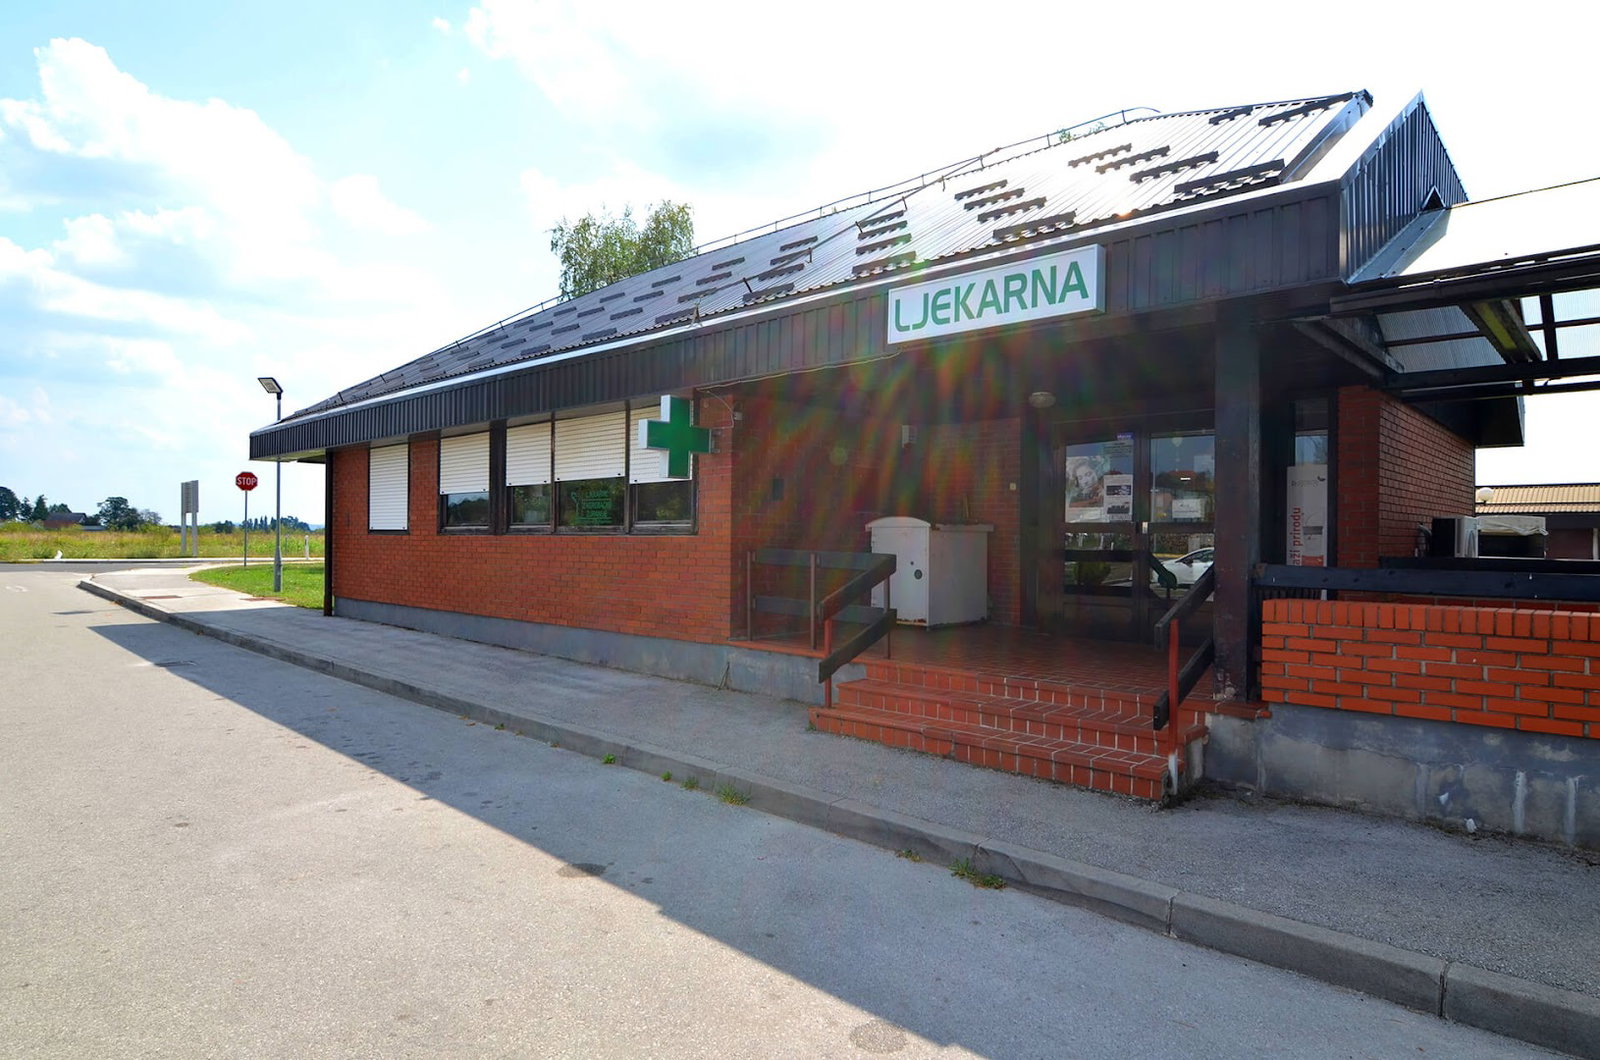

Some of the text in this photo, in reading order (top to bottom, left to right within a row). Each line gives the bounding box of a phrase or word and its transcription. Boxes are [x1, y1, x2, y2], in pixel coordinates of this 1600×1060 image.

[894, 261, 1089, 332] LJEKARNA
[237, 477, 257, 486] STOP
[1290, 507, 1303, 566] aži prirodu
